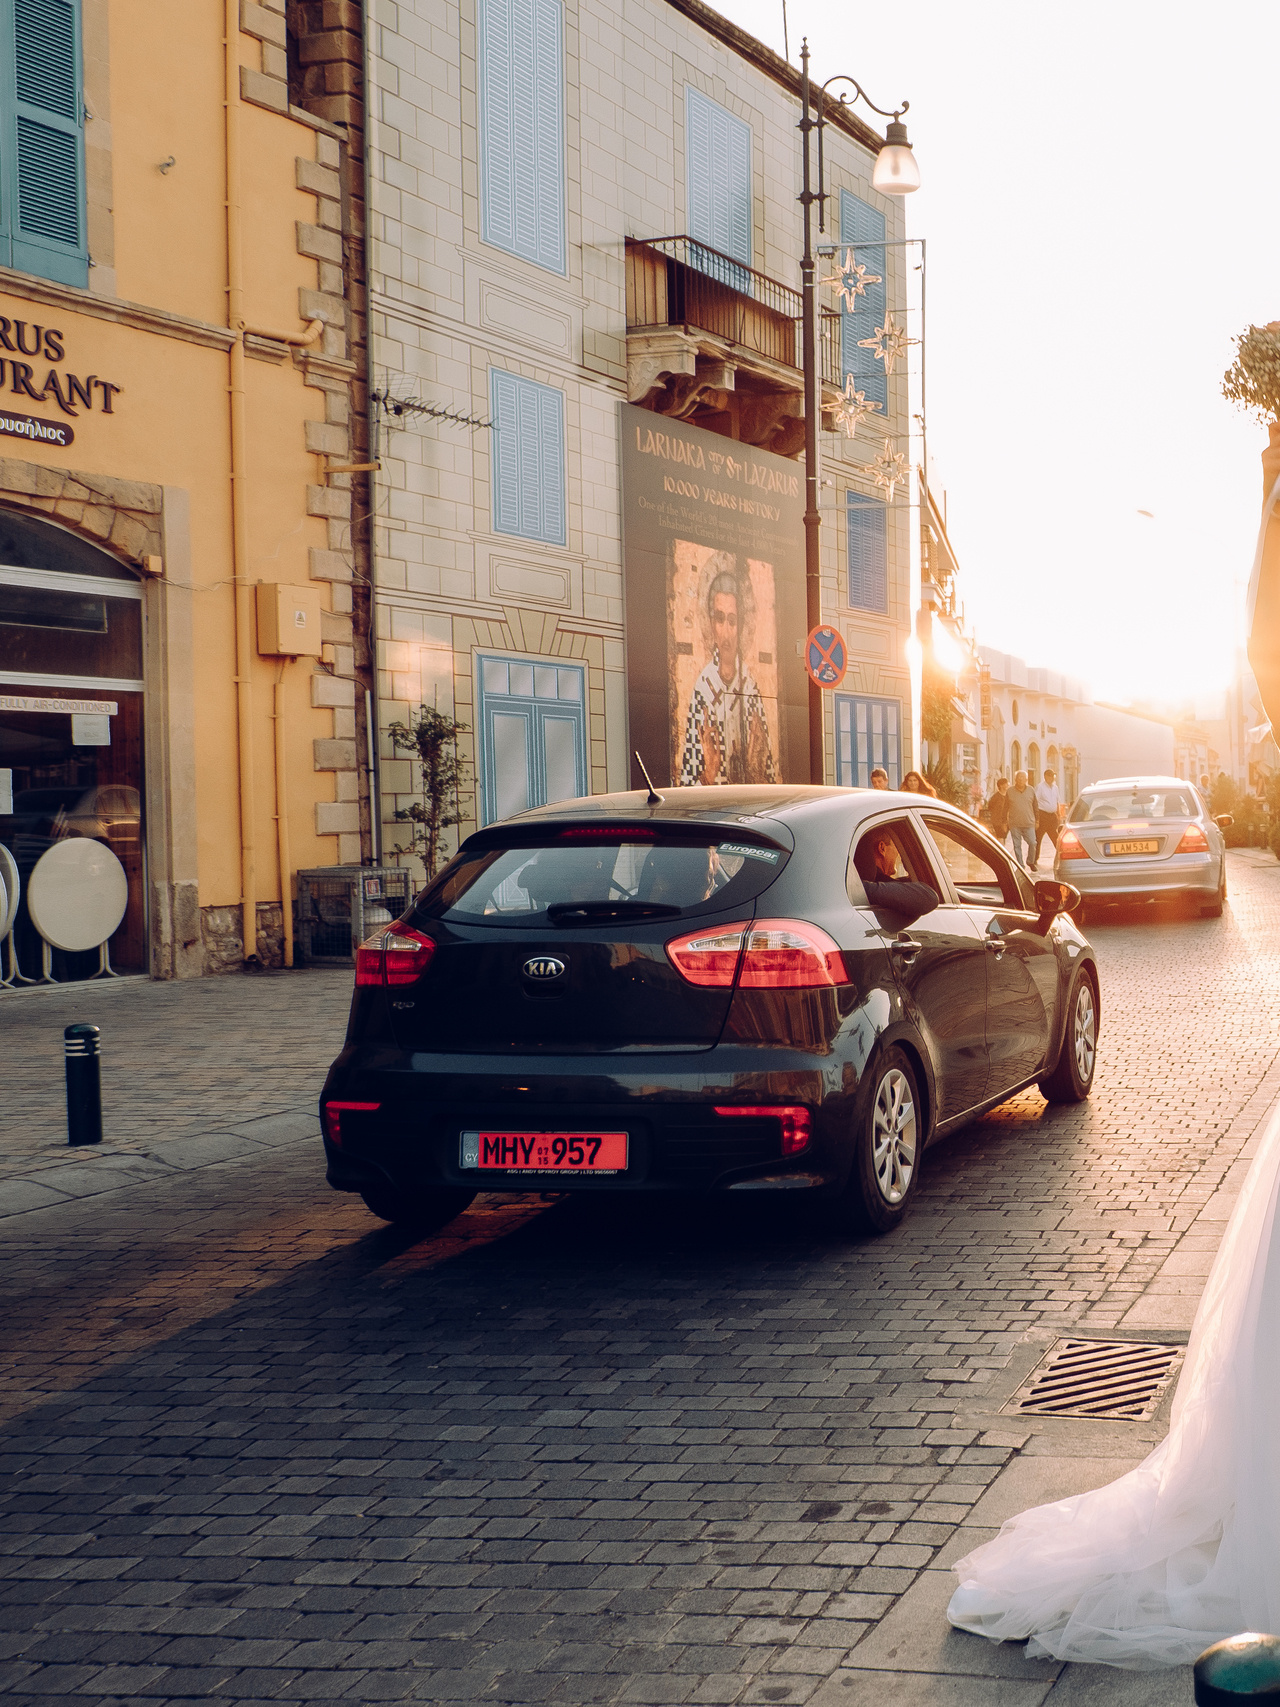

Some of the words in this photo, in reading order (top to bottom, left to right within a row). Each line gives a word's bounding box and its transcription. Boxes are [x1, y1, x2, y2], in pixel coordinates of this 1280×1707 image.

[636, 426, 705, 471] LARNAKA
[744, 460, 798, 501] LAZARUS
[638, 495, 655, 510] One
[657, 499, 665, 513] of
[666, 502, 678, 516] the
[664, 475, 699, 500] 10.000
[703, 486, 736, 511] YEARS
[739, 496, 780, 523] HISTORY
[658, 515, 693, 535] Inhabited
[33, 699, 112, 713] AIR-CONDITIONED
[981, 672, 990, 727] HOTEL
[720, 843, 778, 860] Europcar
[528, 962, 557, 975] KIA
[465, 1153, 478, 1162] CY
[483, 1136, 536, 1165] MHY
[552, 1137, 603, 1166] 957
[537, 1147, 549, 1155] 07
[538, 1157, 549, 1165] 15
